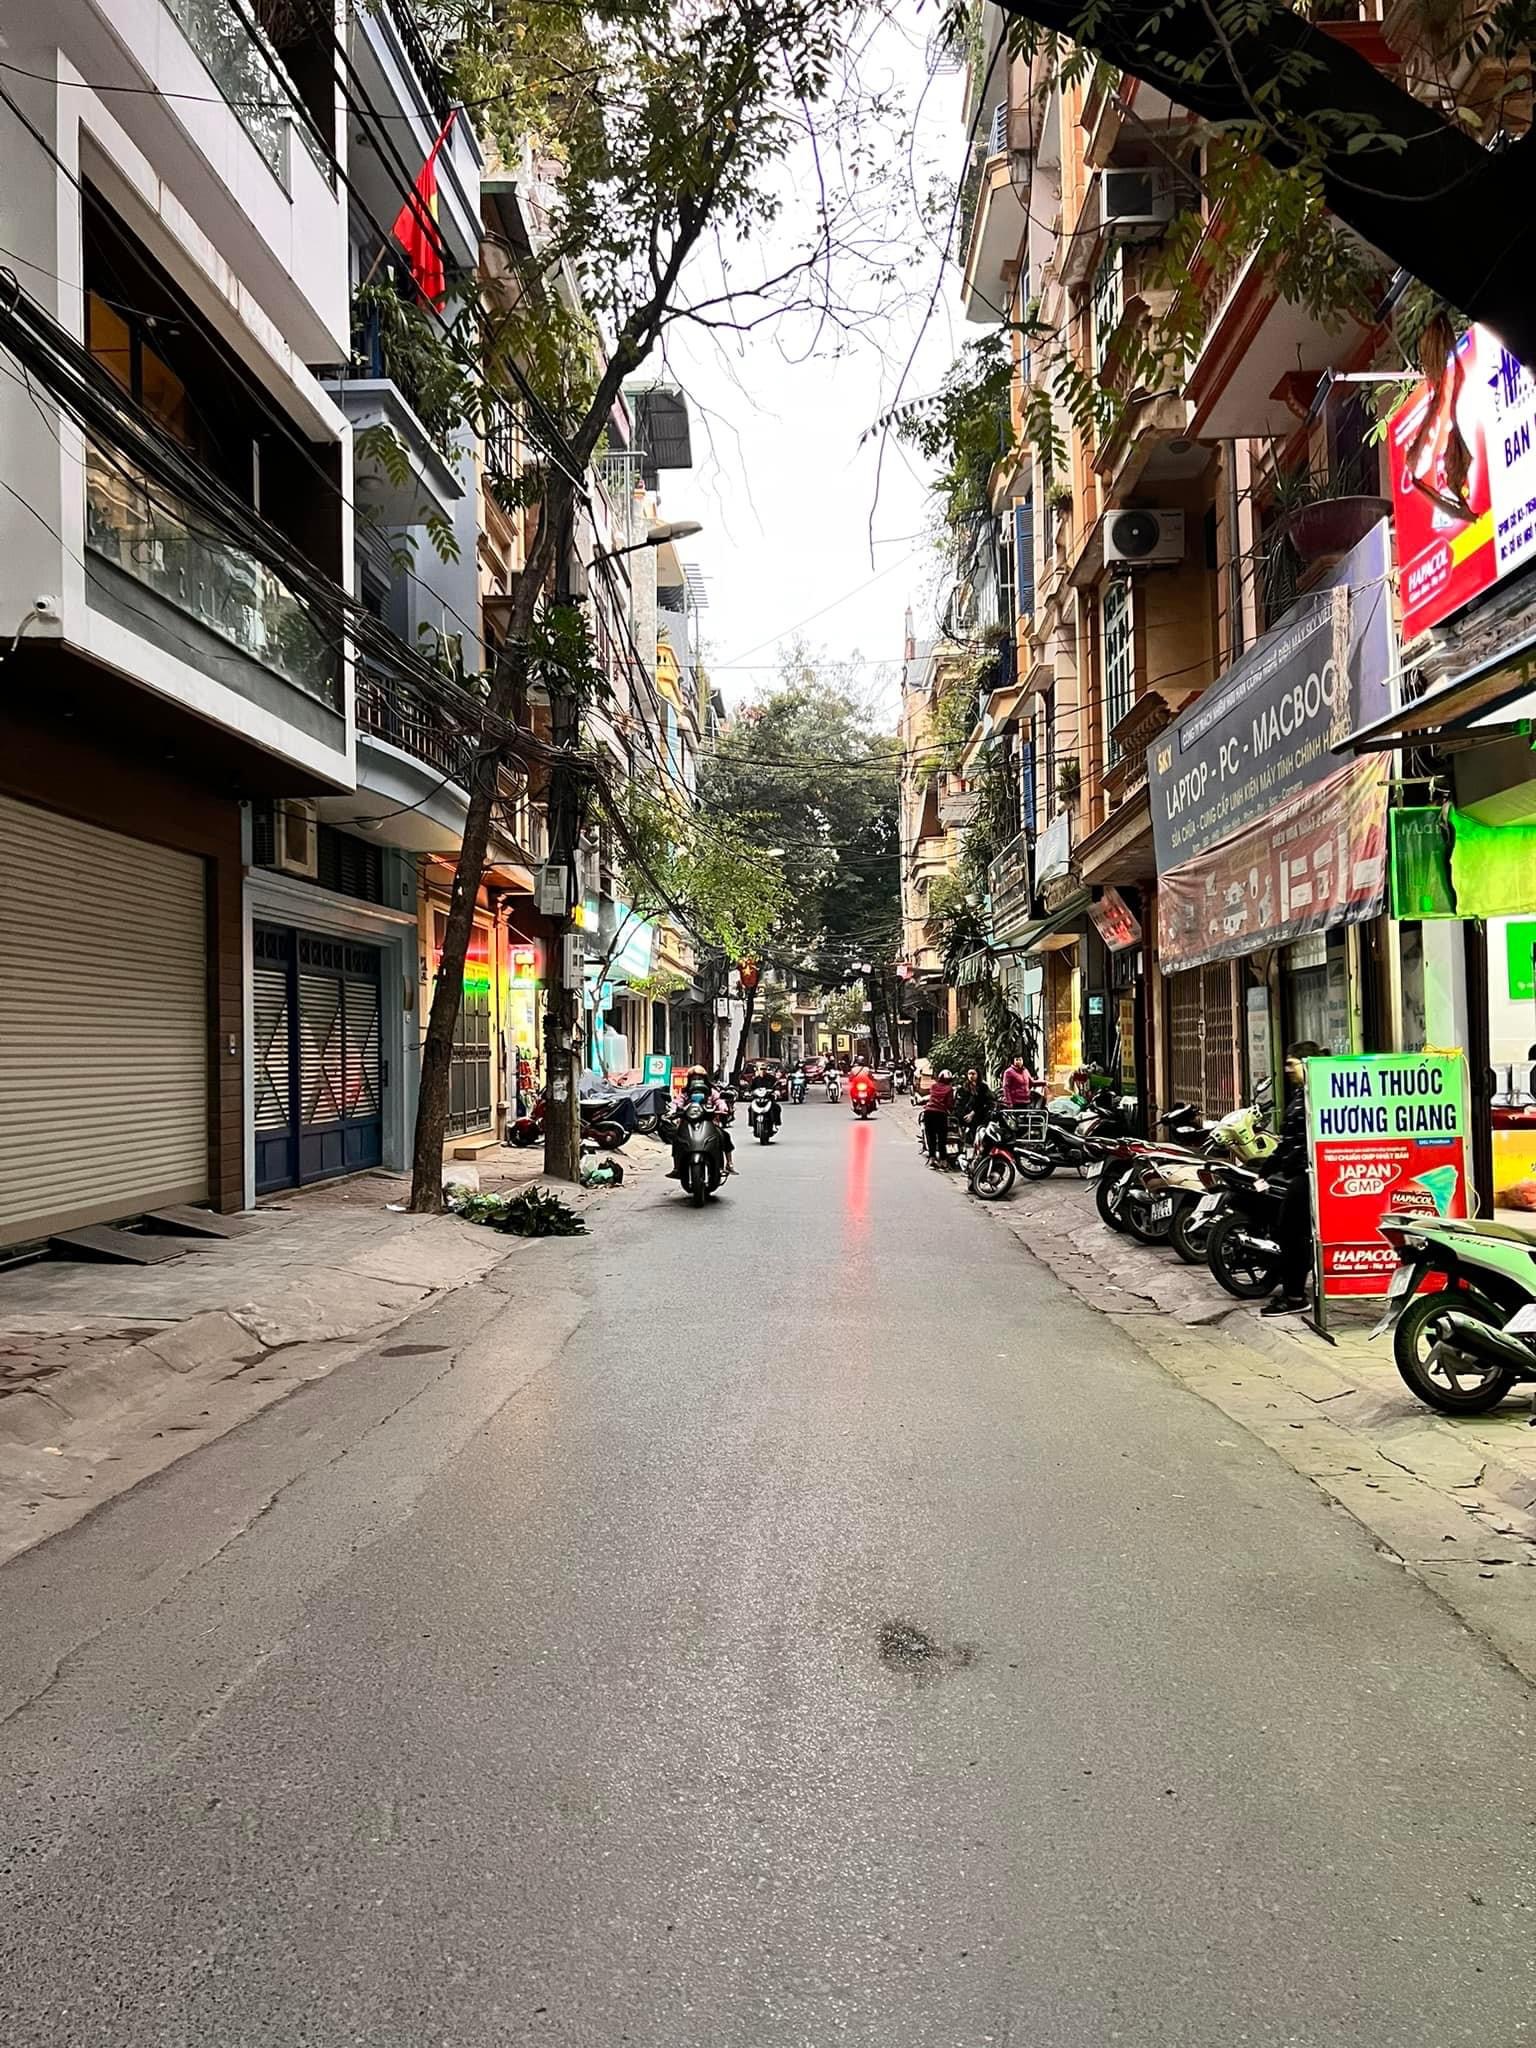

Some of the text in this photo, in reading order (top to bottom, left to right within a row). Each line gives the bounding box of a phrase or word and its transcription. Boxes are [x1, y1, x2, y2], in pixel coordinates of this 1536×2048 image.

[1166, 761, 1207, 820] LAPTOP
[1220, 737, 1240, 781] PC
[1252, 658, 1337, 758] MACBOO
[1157, 744, 1172, 775] SKY
[1331, 1059, 1443, 1098] NHÀ THUỐC
[1320, 1104, 1457, 1134] HƯƠNG GIANG
[1338, 1163, 1391, 1181] JAPAN
[1347, 1181, 1383, 1193] GMP
